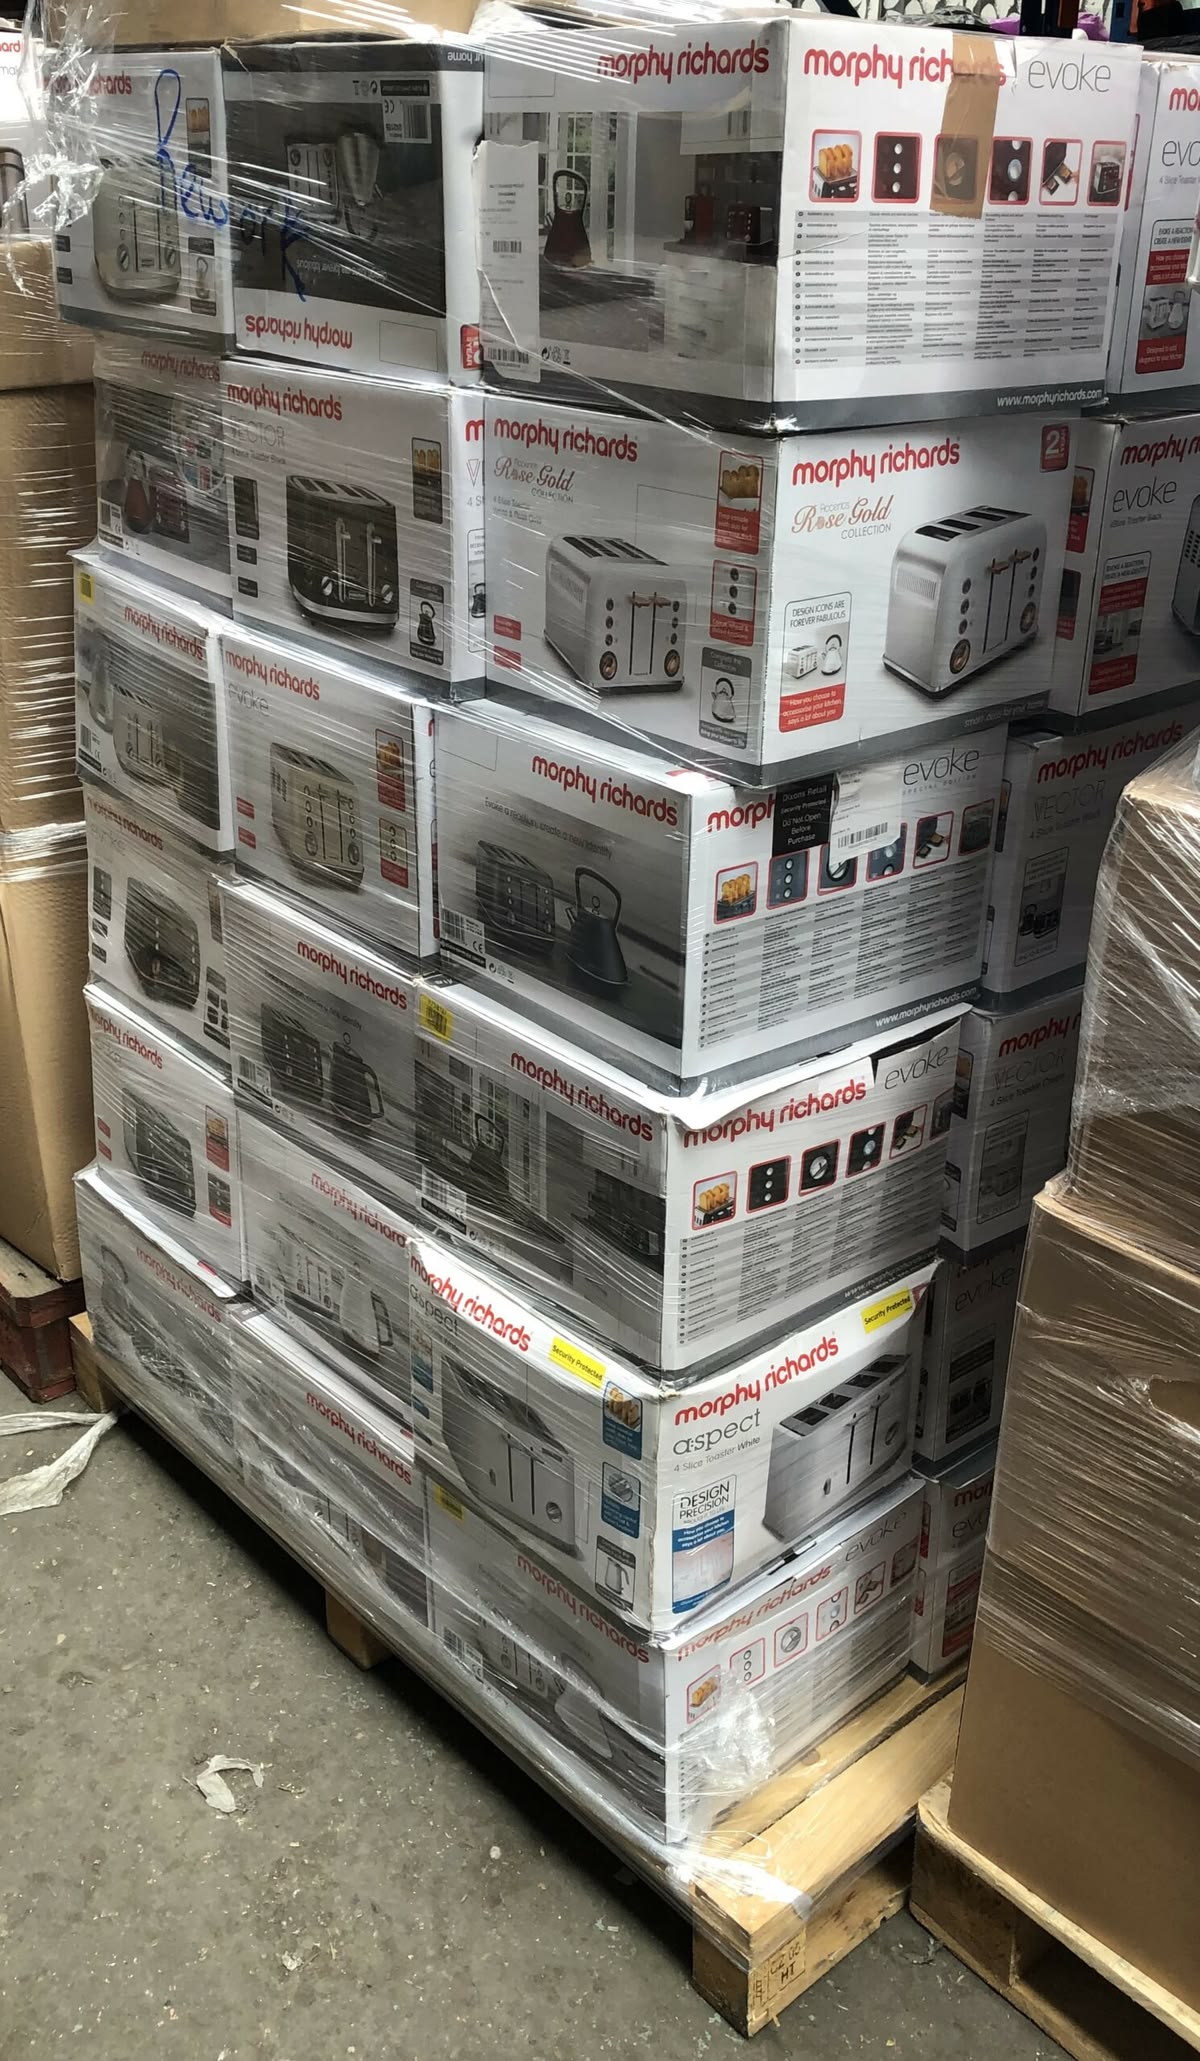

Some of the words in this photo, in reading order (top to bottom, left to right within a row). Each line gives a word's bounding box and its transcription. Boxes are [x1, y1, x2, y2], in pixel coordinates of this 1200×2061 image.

[0, 40, 20, 53] ard
[597, 44, 673, 84] morphy
[677, 40, 769, 75] richards
[804, 44, 902, 89] morphy
[1027, 54, 1112, 93] evoke
[246, 314, 301, 344] richards
[304, 318, 352, 349] morphy
[141, 350, 177, 378] morphy
[178, 357, 220, 382] richards
[227, 383, 281, 416] morphy
[283, 386, 343, 421] richards
[997, 388, 1103, 408] www.morphyrichards.com
[494, 418, 559, 454] morphy
[563, 425, 637, 462] richards
[1046, 430, 1060, 454] 2
[1120, 434, 1187, 467] morphy
[494, 456, 535, 484] Rose
[536, 464, 575, 492] Gold
[792, 450, 875, 487] morphy
[879, 437, 960, 474] richards
[1112, 476, 1177, 513] evoke
[791, 505, 844, 533] Rose
[847, 495, 894, 527] Gold
[841, 524, 891, 540] COLLECTION
[790, 616, 816, 628] FOREVER
[816, 610, 845, 623] FABULOUS
[792, 607, 815, 617] DESIGN
[834, 600, 845, 609] ARE
[124, 607, 160, 643] morphy
[161, 622, 203, 660] richards
[226, 651, 268, 684] morphy
[269, 664, 320, 700] richards
[903, 748, 980, 786] evoke
[1037, 745, 1108, 784] morphy
[1111, 721, 1183, 761] richards
[532, 755, 596, 803] morphy
[600, 777, 677, 826] richards
[781, 804, 801, 815] Security
[782, 791, 806, 802] Dixons
[807, 785, 827, 796] Retail
[782, 819, 791, 827] Do
[792, 816, 804, 825] Not
[804, 813, 822, 824] Open
[787, 833, 816, 845] Purchase
[791, 825, 811, 835] Before
[297, 941, 348, 984] morphy
[350, 966, 408, 1010] richards
[875, 986, 977, 1027] www.morphyrichards.com
[122, 1030, 163, 1070] richards
[999, 1015, 1068, 1057] morphy
[884, 1046, 948, 1090] evoke
[511, 1052, 575, 1105] morphy
[577, 1086, 653, 1141] richards
[684, 1109, 775, 1148] morphy
[779, 1079, 867, 1125] richards
[359, 1206, 407, 1248] richard
[410, 1255, 463, 1312] morphy
[464, 1296, 532, 1352] richards
[865, 1311, 886, 1325] Security
[886, 1297, 911, 1313] Protected
[552, 1345, 577, 1366] Security
[575, 1358, 603, 1380] Protected
[675, 1378, 761, 1425] morphy
[764, 1336, 839, 1392] richards
[306, 1392, 356, 1442] morphy
[357, 1430, 412, 1486] richards
[674, 1464, 681, 1472] 4
[682, 1459, 703, 1471] Slice
[706, 1448, 736, 1465] Toaster
[737, 1436, 760, 1453] White
[679, 1494, 730, 1520] PRECISION
[680, 1481, 730, 1509] DESIGN
[517, 1553, 577, 1609] morphy
[579, 1605, 650, 1664] richards
[678, 1612, 751, 1662] morphy
[755, 1566, 832, 1619] richards
[781, 1961, 795, 1984] HT
